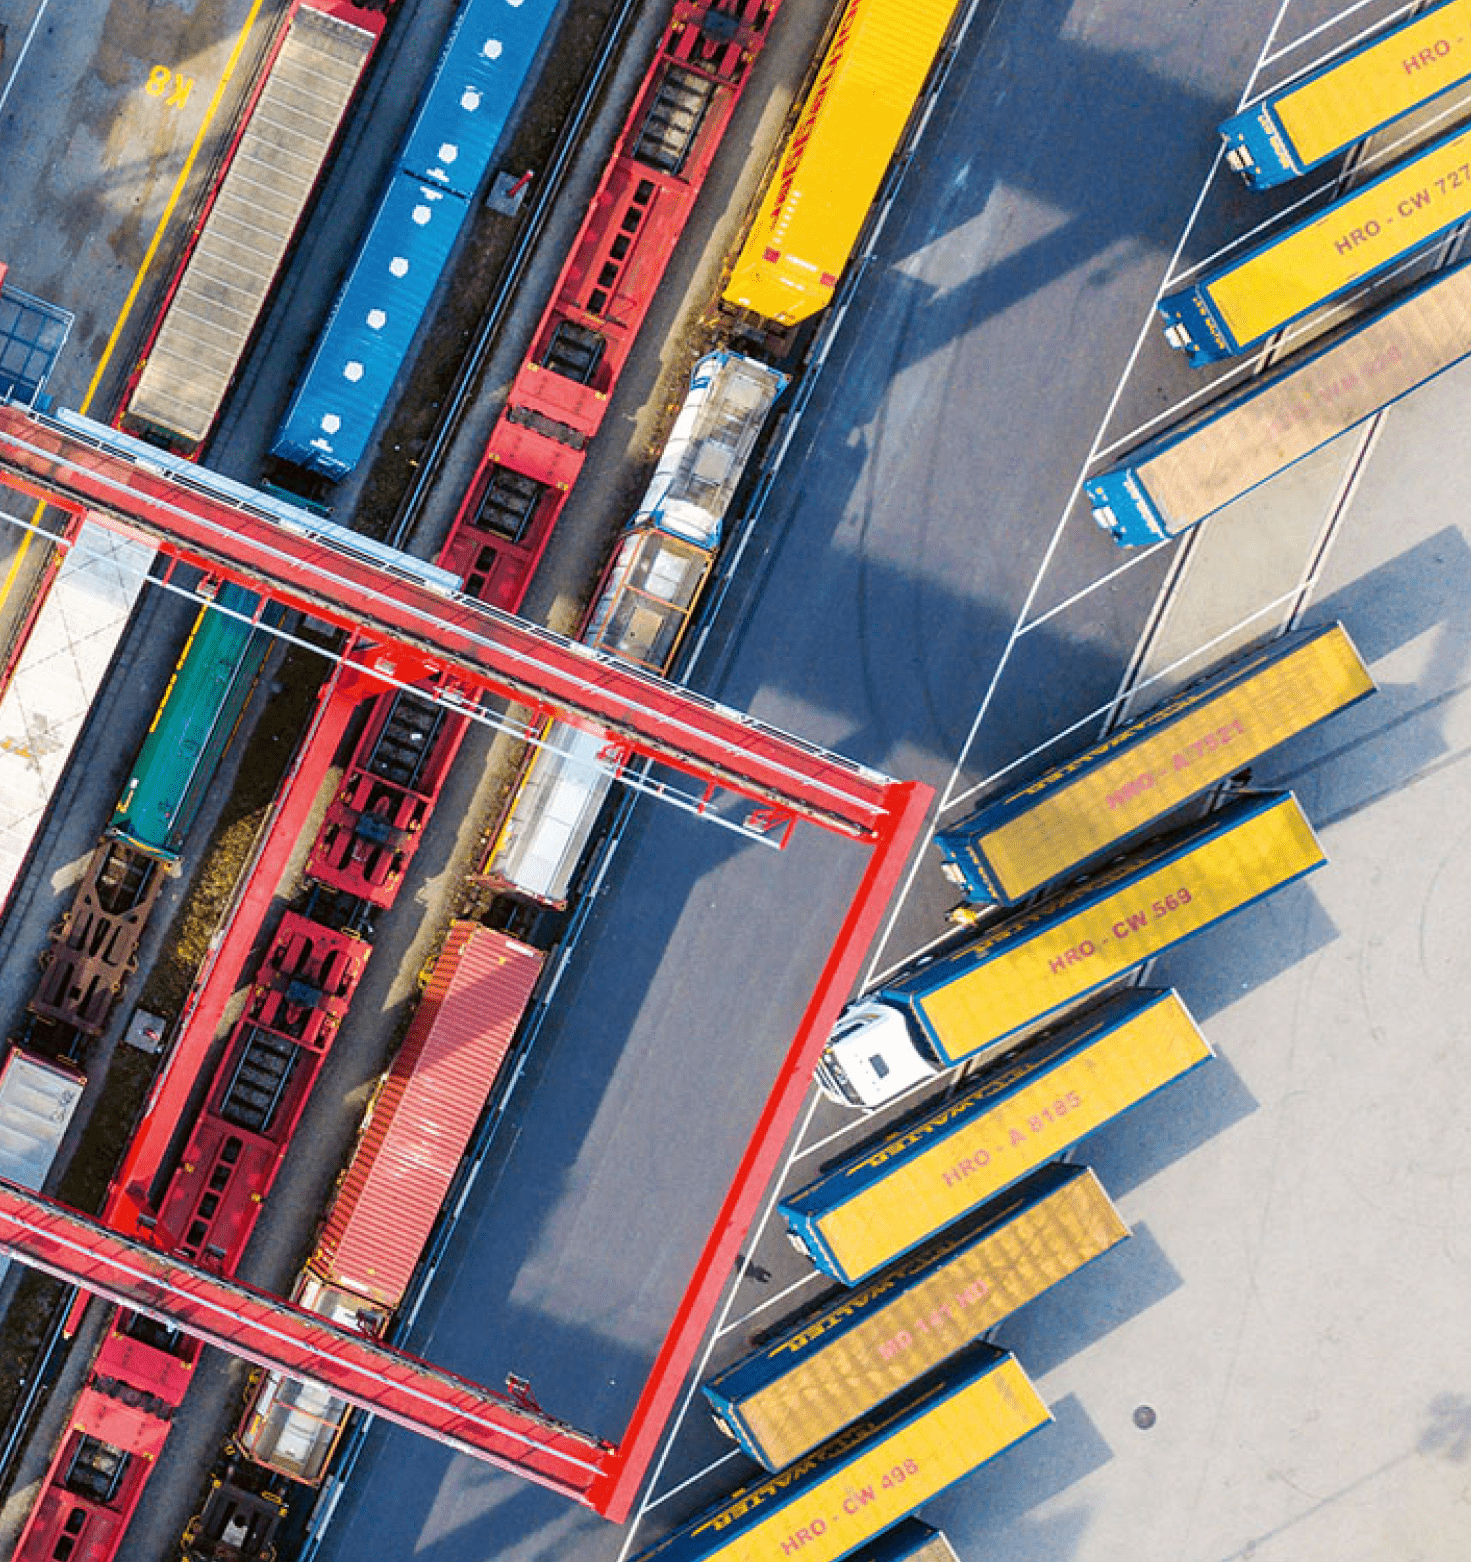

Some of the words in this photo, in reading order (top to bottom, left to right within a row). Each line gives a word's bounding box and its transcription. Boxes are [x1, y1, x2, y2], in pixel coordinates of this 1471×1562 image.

[145, 64, 194, 109] K8
[1403, 39, 1450, 74] HRO
[1335, 219, 1380, 254] HRO
[1397, 190, 1430, 216] CW
[1172, 753, 1189, 771] A
[1049, 940, 1095, 973] HRO
[1111, 910, 1147, 938] CW
[1151, 889, 1191, 916] 569
[942, 1148, 990, 1186] HRO
[1009, 1128, 1026, 1145] A
[713, 1456, 819, 1531] WALTER
[781, 1518, 826, 1555] HRO
[842, 1485, 875, 1514] CW
